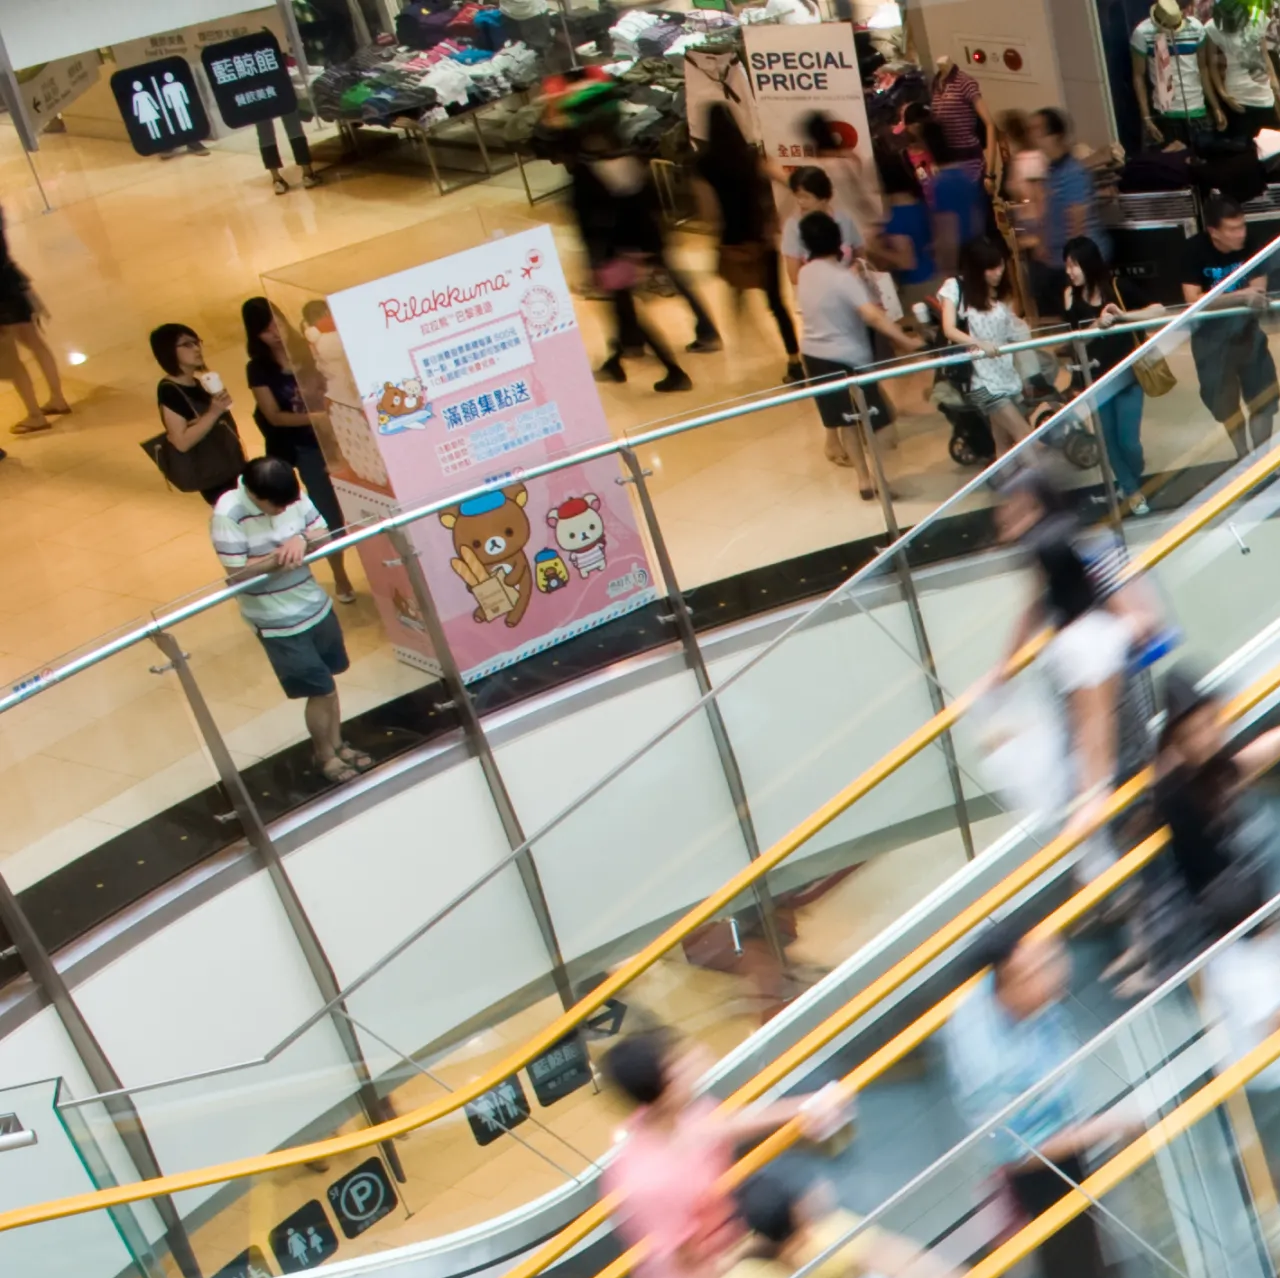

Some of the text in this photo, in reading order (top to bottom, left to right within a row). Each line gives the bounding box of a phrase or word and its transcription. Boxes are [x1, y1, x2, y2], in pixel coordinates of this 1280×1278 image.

[211, 48, 279, 84] 藍鯨館
[751, 51, 853, 71] SPECIAL
[756, 72, 828, 92] PRICE
